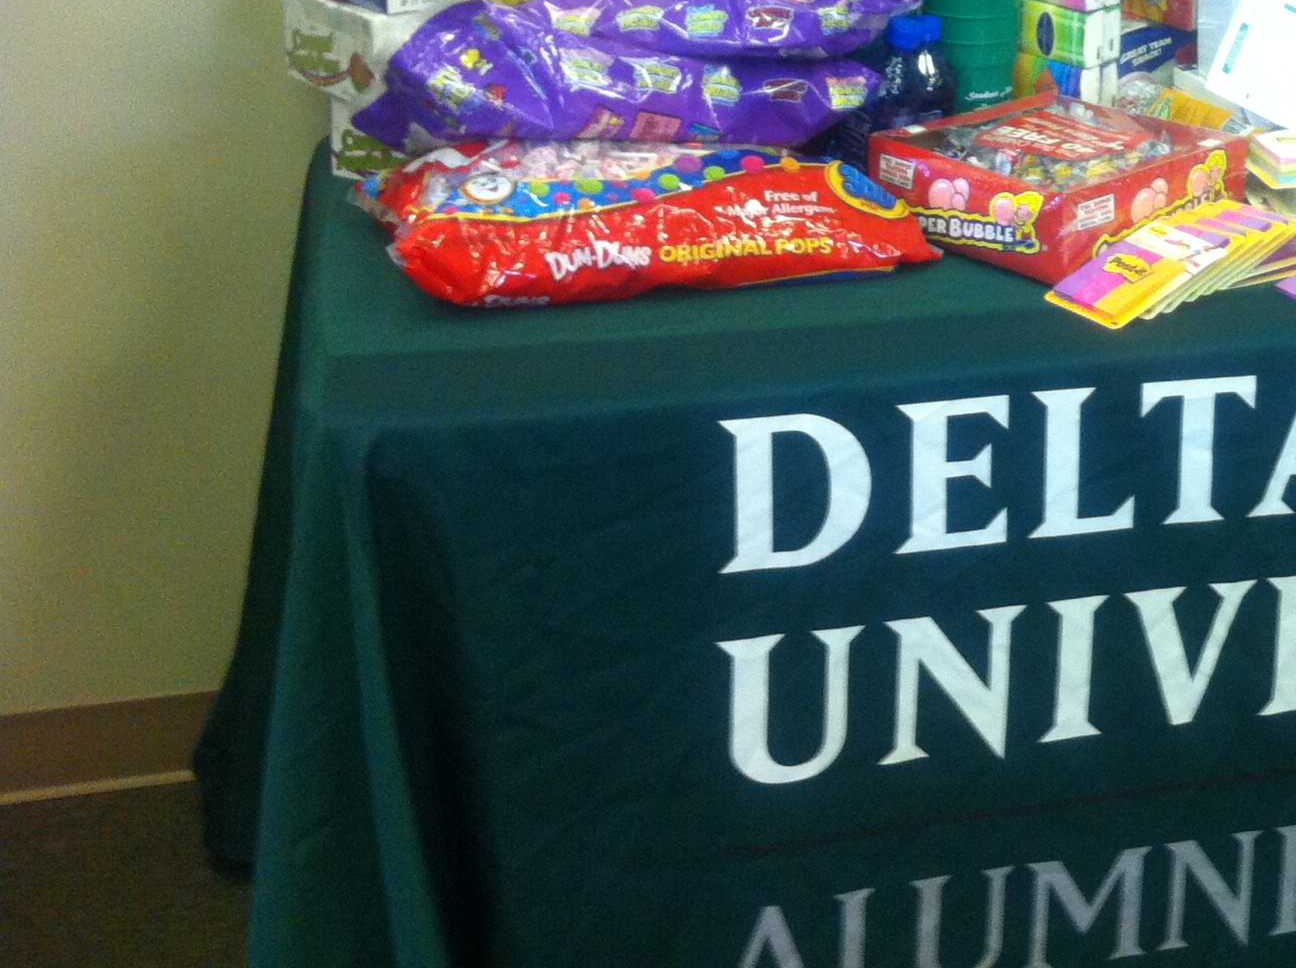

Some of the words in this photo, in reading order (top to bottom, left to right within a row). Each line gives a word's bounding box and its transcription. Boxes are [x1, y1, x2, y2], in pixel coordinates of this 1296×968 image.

[763, 189, 800, 202] Free
[801, 191, 819, 203] of
[918, 216, 947, 233] PER
[949, 218, 1015, 243] BUBBLE
[659, 238, 772, 263] ORIGINAL
[775, 236, 833, 255] POPS
